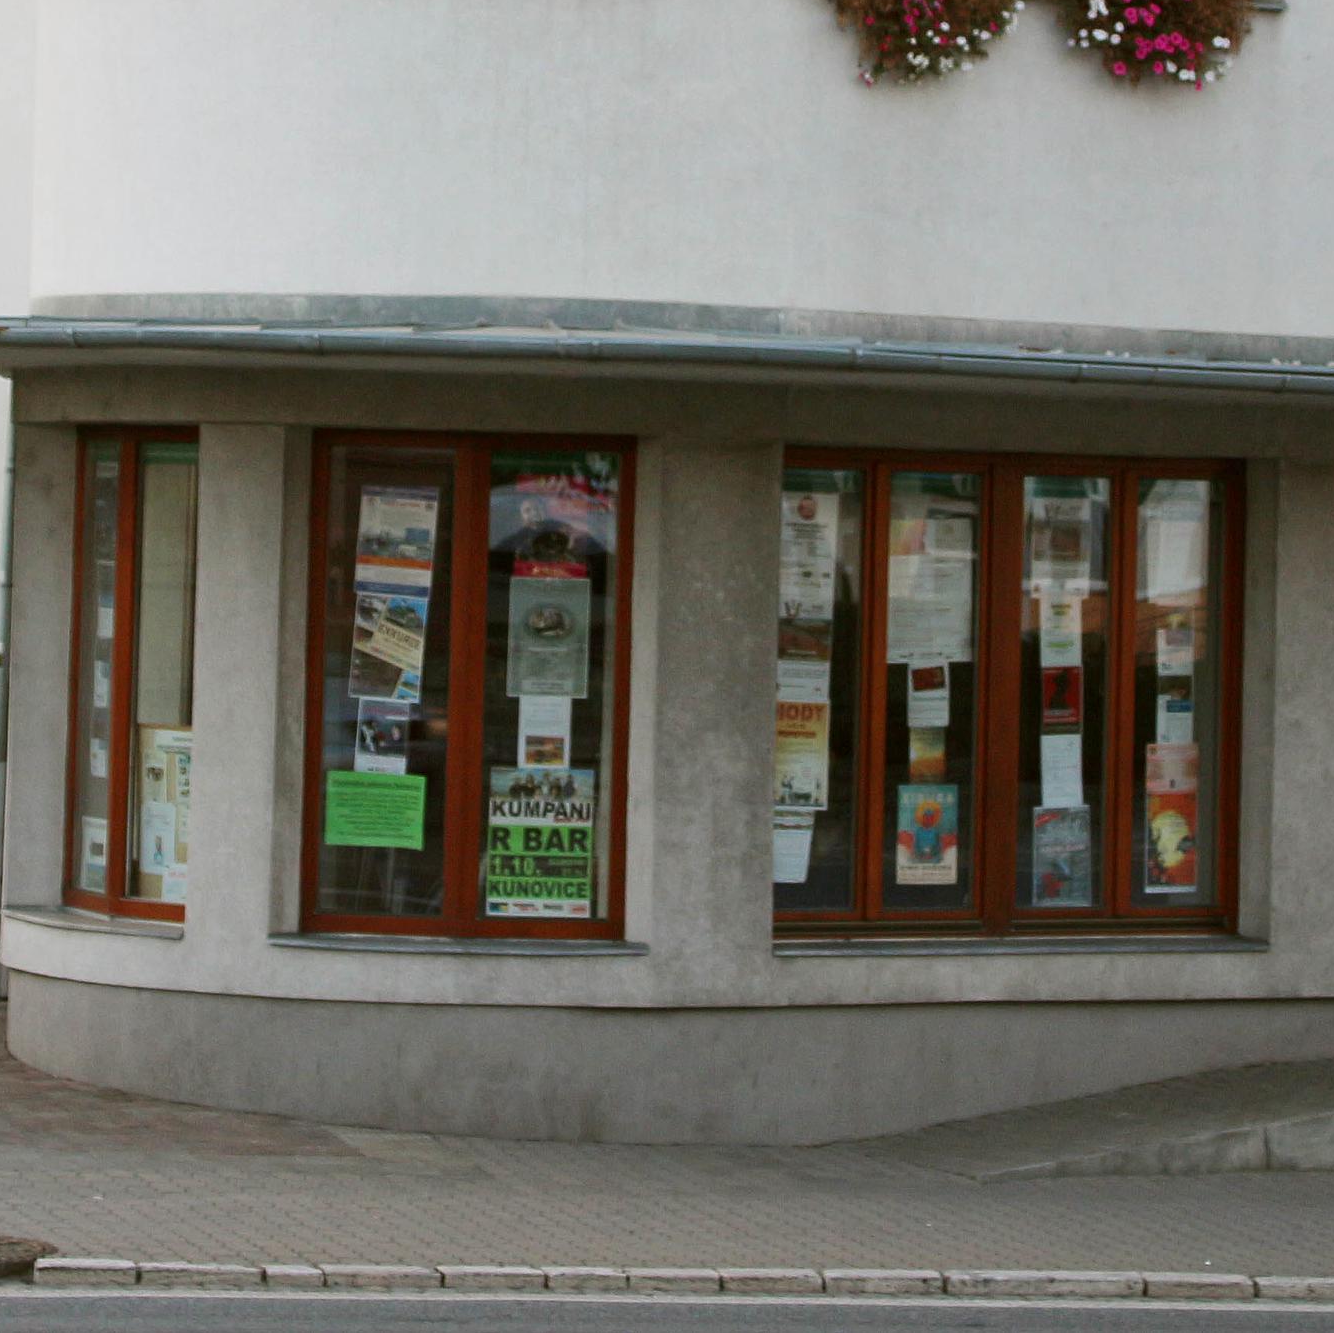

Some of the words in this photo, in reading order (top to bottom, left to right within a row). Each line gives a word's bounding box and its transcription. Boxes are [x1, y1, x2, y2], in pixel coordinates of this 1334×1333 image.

[491, 827, 511, 851] R
[524, 827, 588, 852] BAR
[489, 879, 588, 898] KUNOVICE
